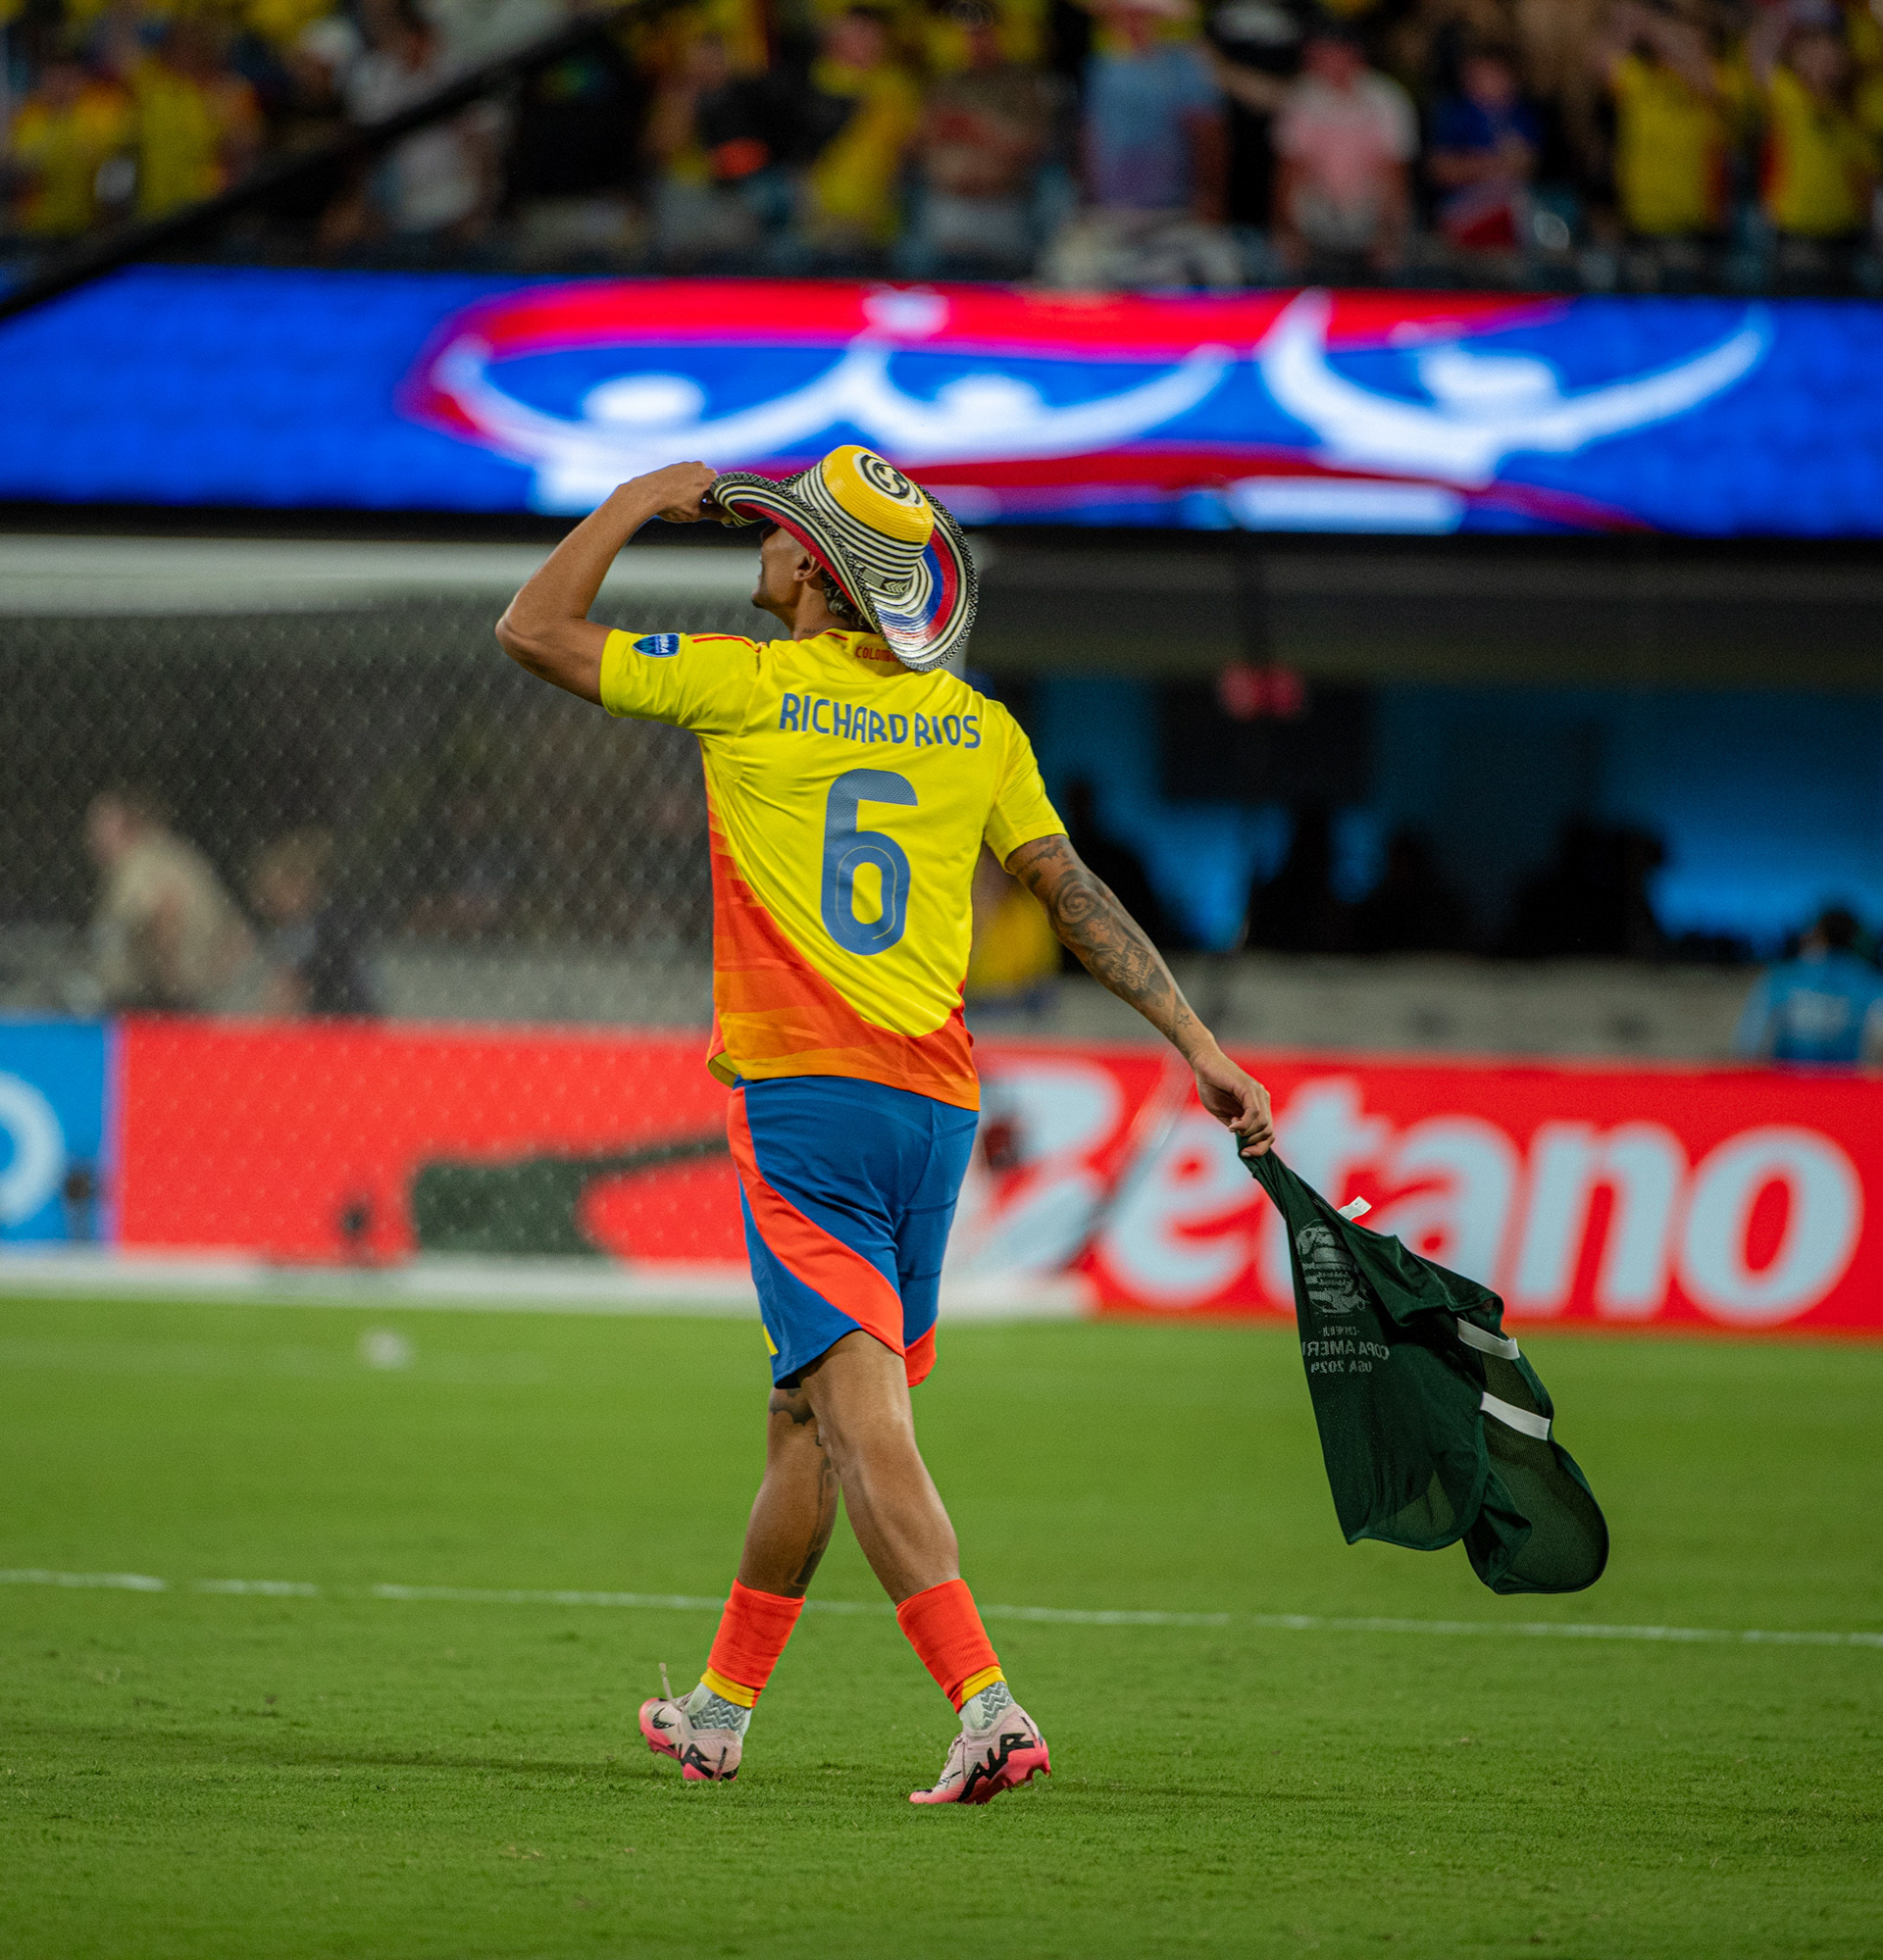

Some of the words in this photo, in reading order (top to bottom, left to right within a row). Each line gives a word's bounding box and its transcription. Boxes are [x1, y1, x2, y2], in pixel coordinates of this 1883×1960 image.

[779, 692, 908, 744] RICHARD
[914, 712, 982, 749] RIOS
[820, 768, 918, 956] 6
